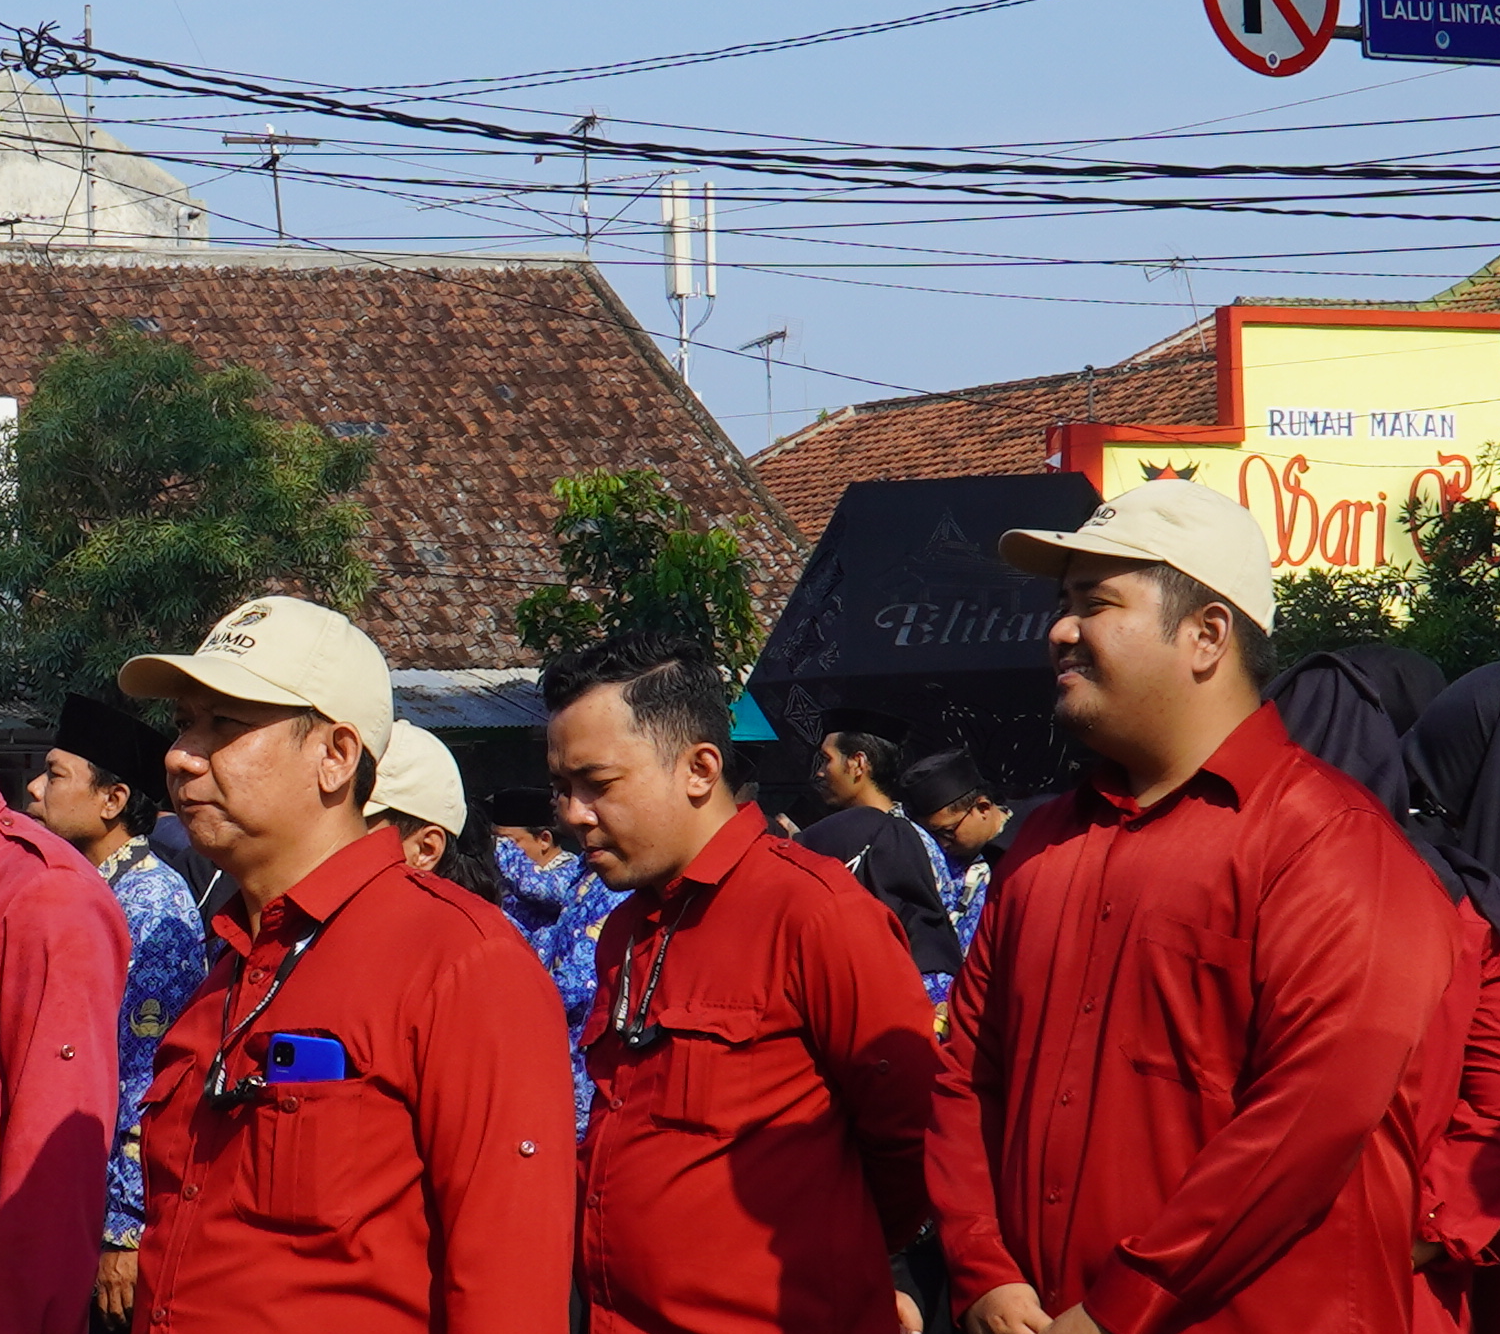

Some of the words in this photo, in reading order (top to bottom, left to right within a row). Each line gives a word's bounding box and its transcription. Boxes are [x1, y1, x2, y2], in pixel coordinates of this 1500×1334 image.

[1381, 0, 1432, 21] LALU
[1269, 409, 1352, 437] RUMAH
[1371, 412, 1454, 438] MAKAN
